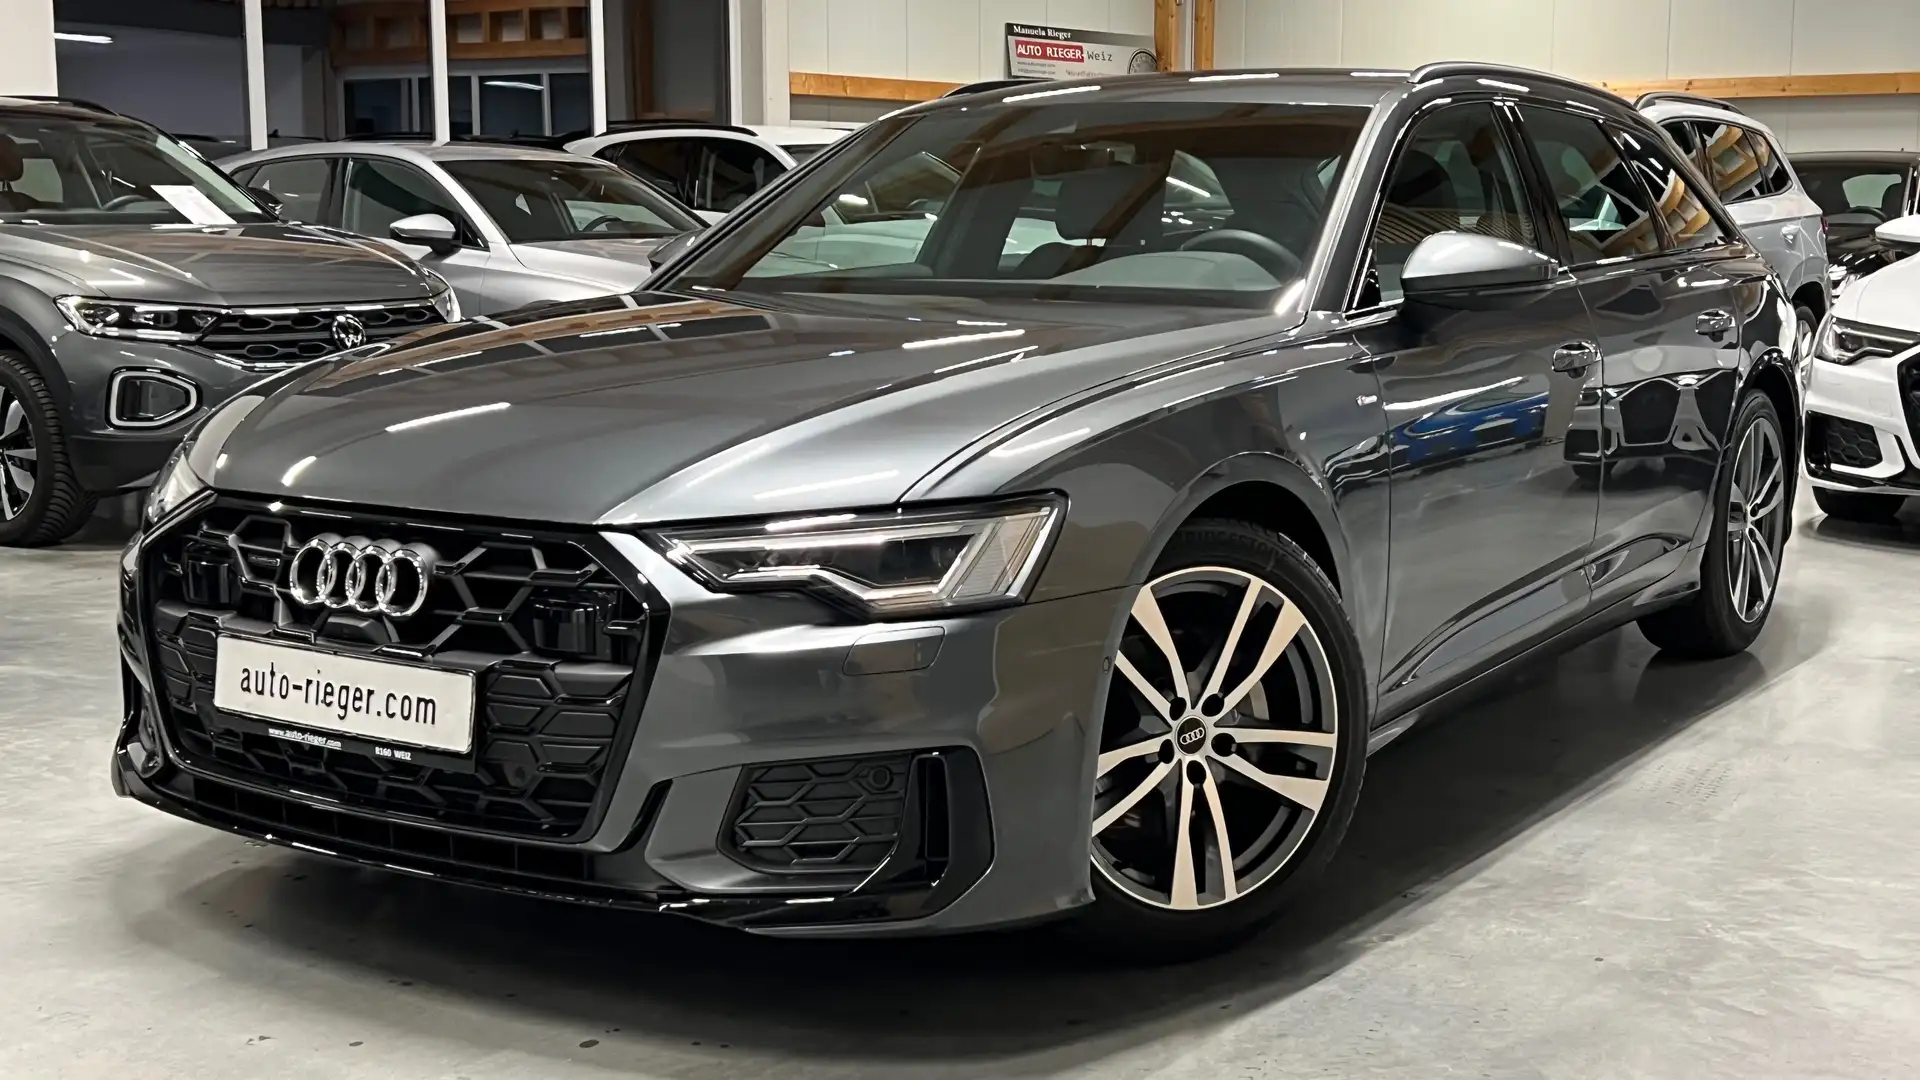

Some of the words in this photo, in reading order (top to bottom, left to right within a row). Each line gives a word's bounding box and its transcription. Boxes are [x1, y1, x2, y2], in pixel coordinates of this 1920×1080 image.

[1013, 25, 1046, 36] Manuela
[1047, 29, 1071, 40] Rieger
[1017, 44, 1041, 56] AUTO
[1087, 51, 1113, 62] Weiz
[240, 662, 436, 725] auto-rieger.com
[268, 728, 342, 749] www.auto-rieger.com
[394, 750, 412, 761] WEIZ
